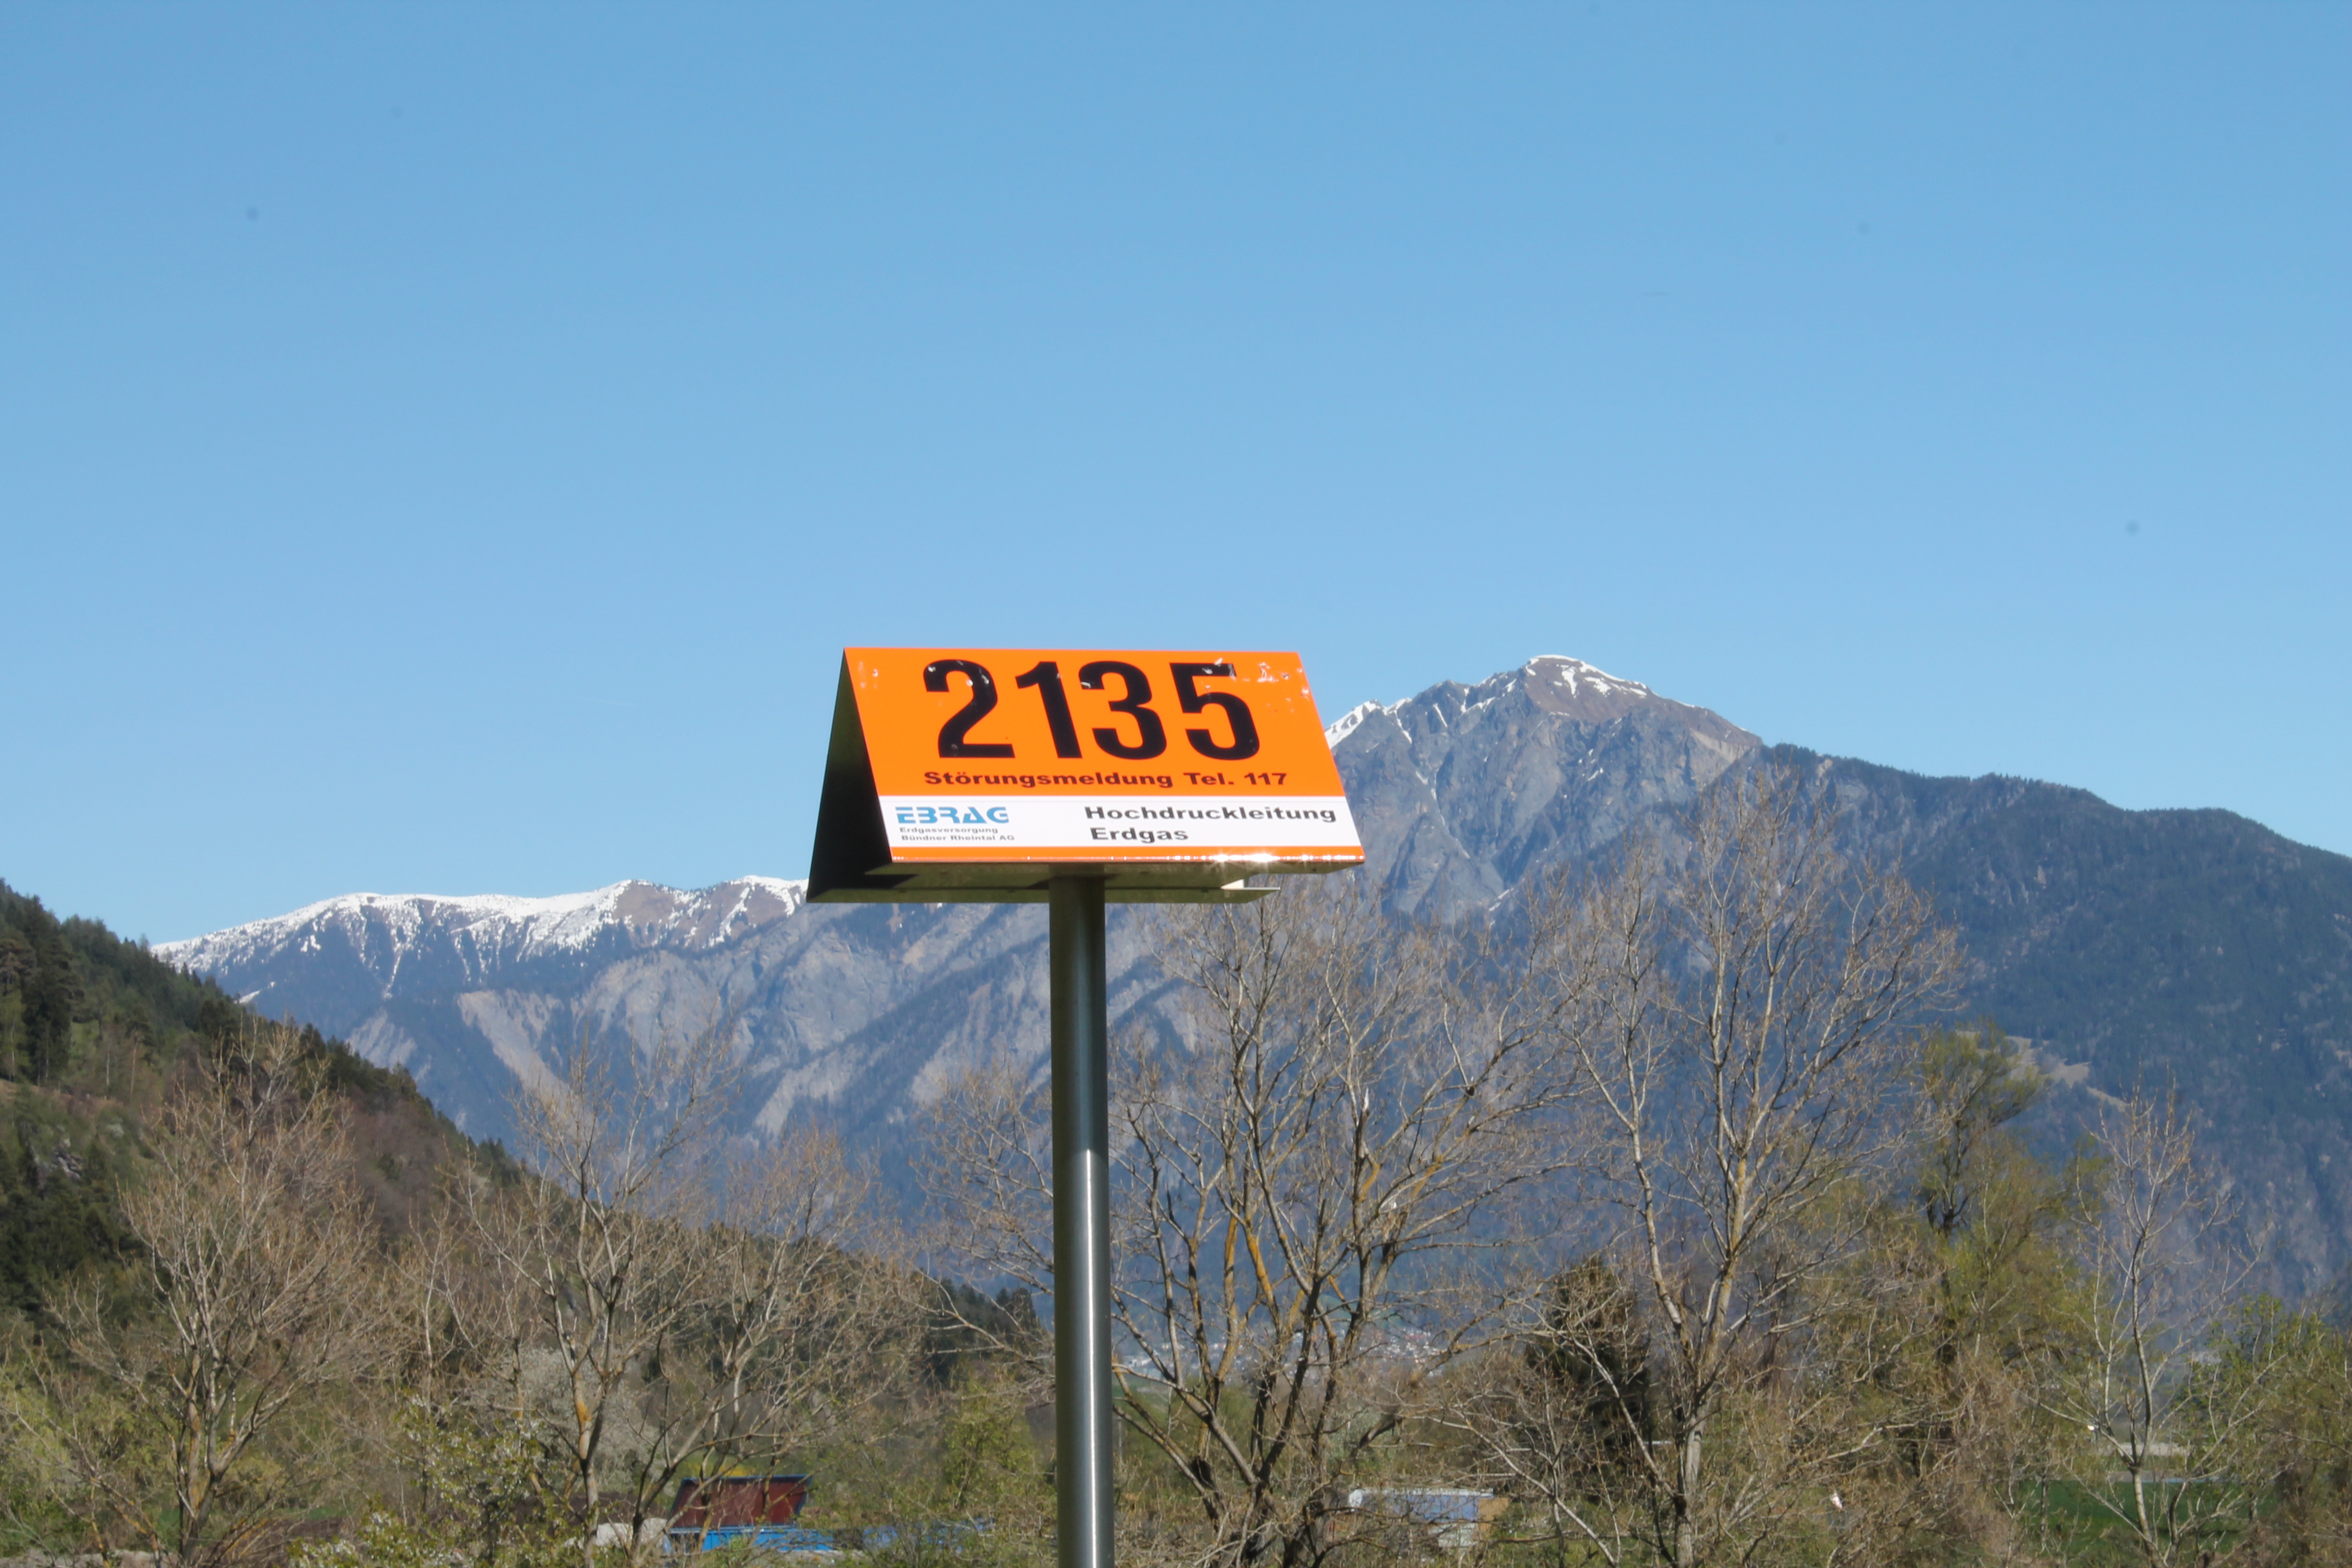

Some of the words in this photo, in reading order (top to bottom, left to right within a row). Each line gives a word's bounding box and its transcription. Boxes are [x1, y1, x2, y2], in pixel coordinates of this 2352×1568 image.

[923, 660, 1260, 760] 2135
[924, 772, 1173, 788] Störungsmeldung
[1184, 772, 1234, 785] Tel.
[1244, 772, 1287, 785] 117
[895, 807, 1009, 824] EBRAG
[1085, 807, 1336, 823] Hochdruckleitung
[1090, 827, 1188, 844] Erdgas
